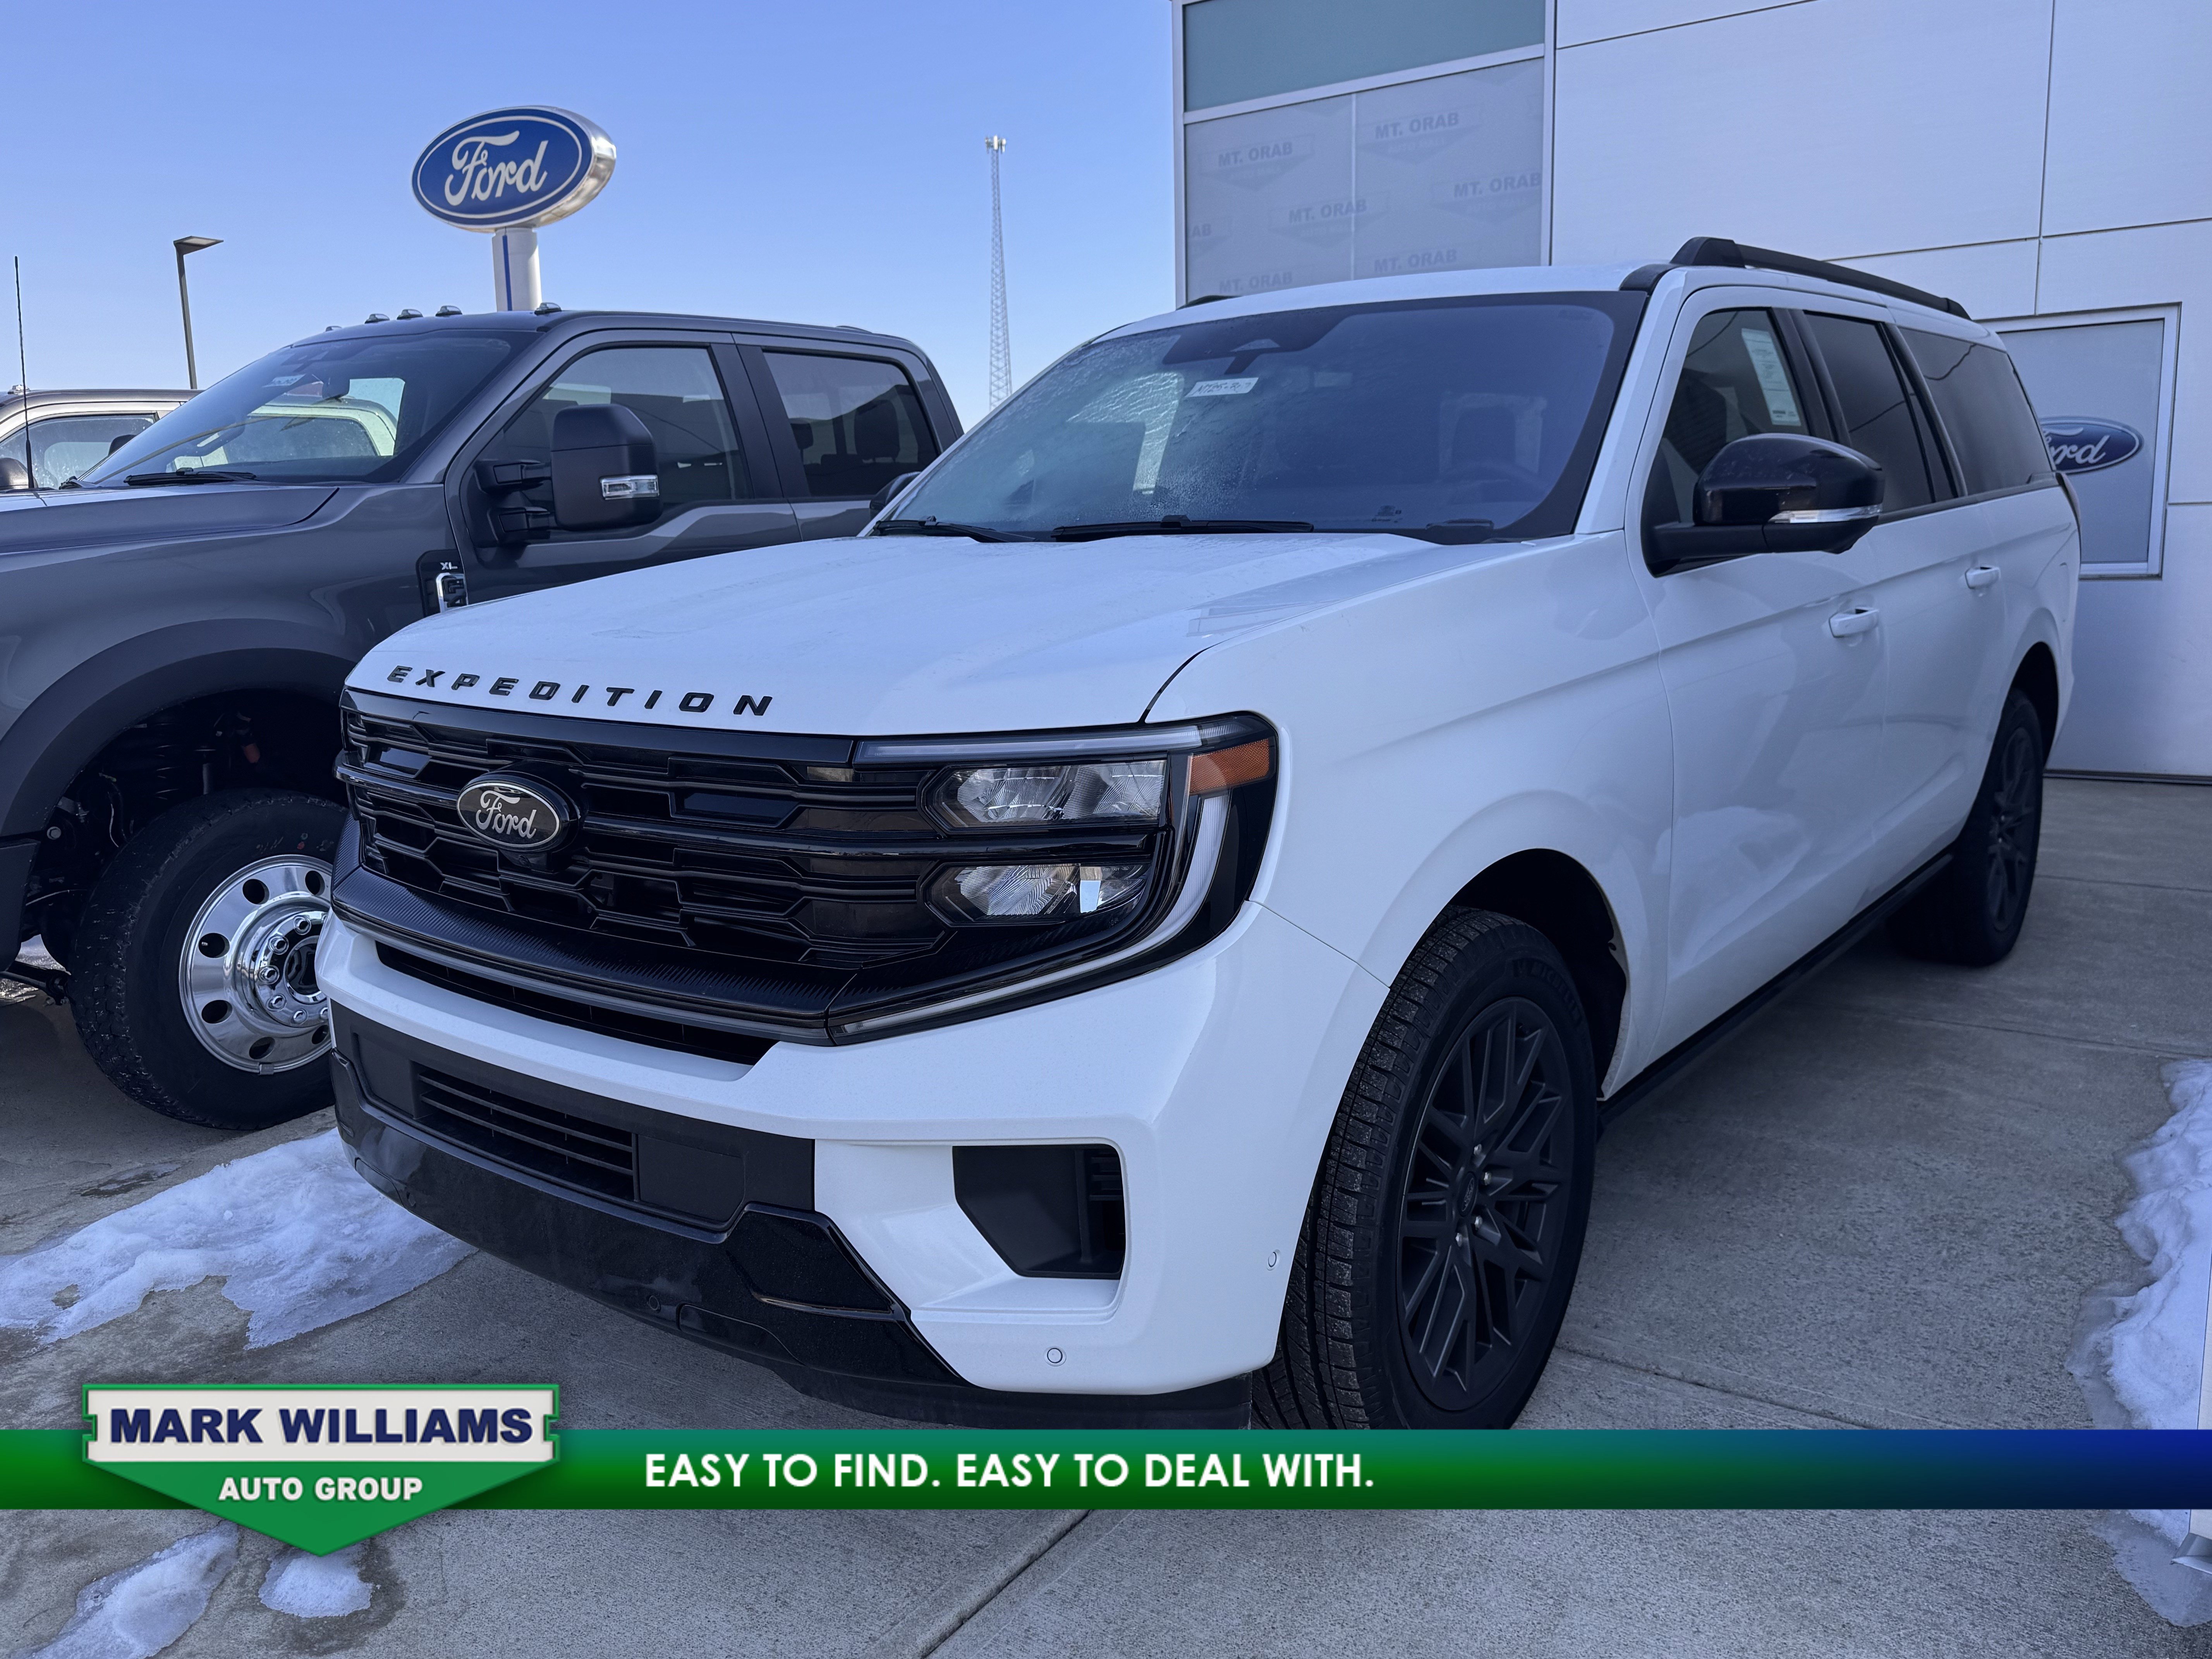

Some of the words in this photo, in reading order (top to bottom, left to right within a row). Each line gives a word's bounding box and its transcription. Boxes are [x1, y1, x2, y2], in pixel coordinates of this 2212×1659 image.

[1376, 122, 1402, 139] MT.
[1409, 112, 1459, 132] ORAB
[1218, 151, 1243, 167] MT.
[1249, 142, 1293, 161] ORAB
[445, 130, 548, 206] Ford
[1454, 181, 1482, 198] MT.
[1490, 173, 1542, 192] ORAB
[1288, 208, 1314, 223] MT.
[1321, 199, 1367, 218] ORAB
[1375, 257, 1402, 272] MT.
[1408, 249, 1457, 268] ORAB
[1249, 271, 1293, 289] ORAB
[440, 562, 458, 570] XL
[387, 665, 773, 716] EXPEDITION
[476, 790, 537, 839] Ford
